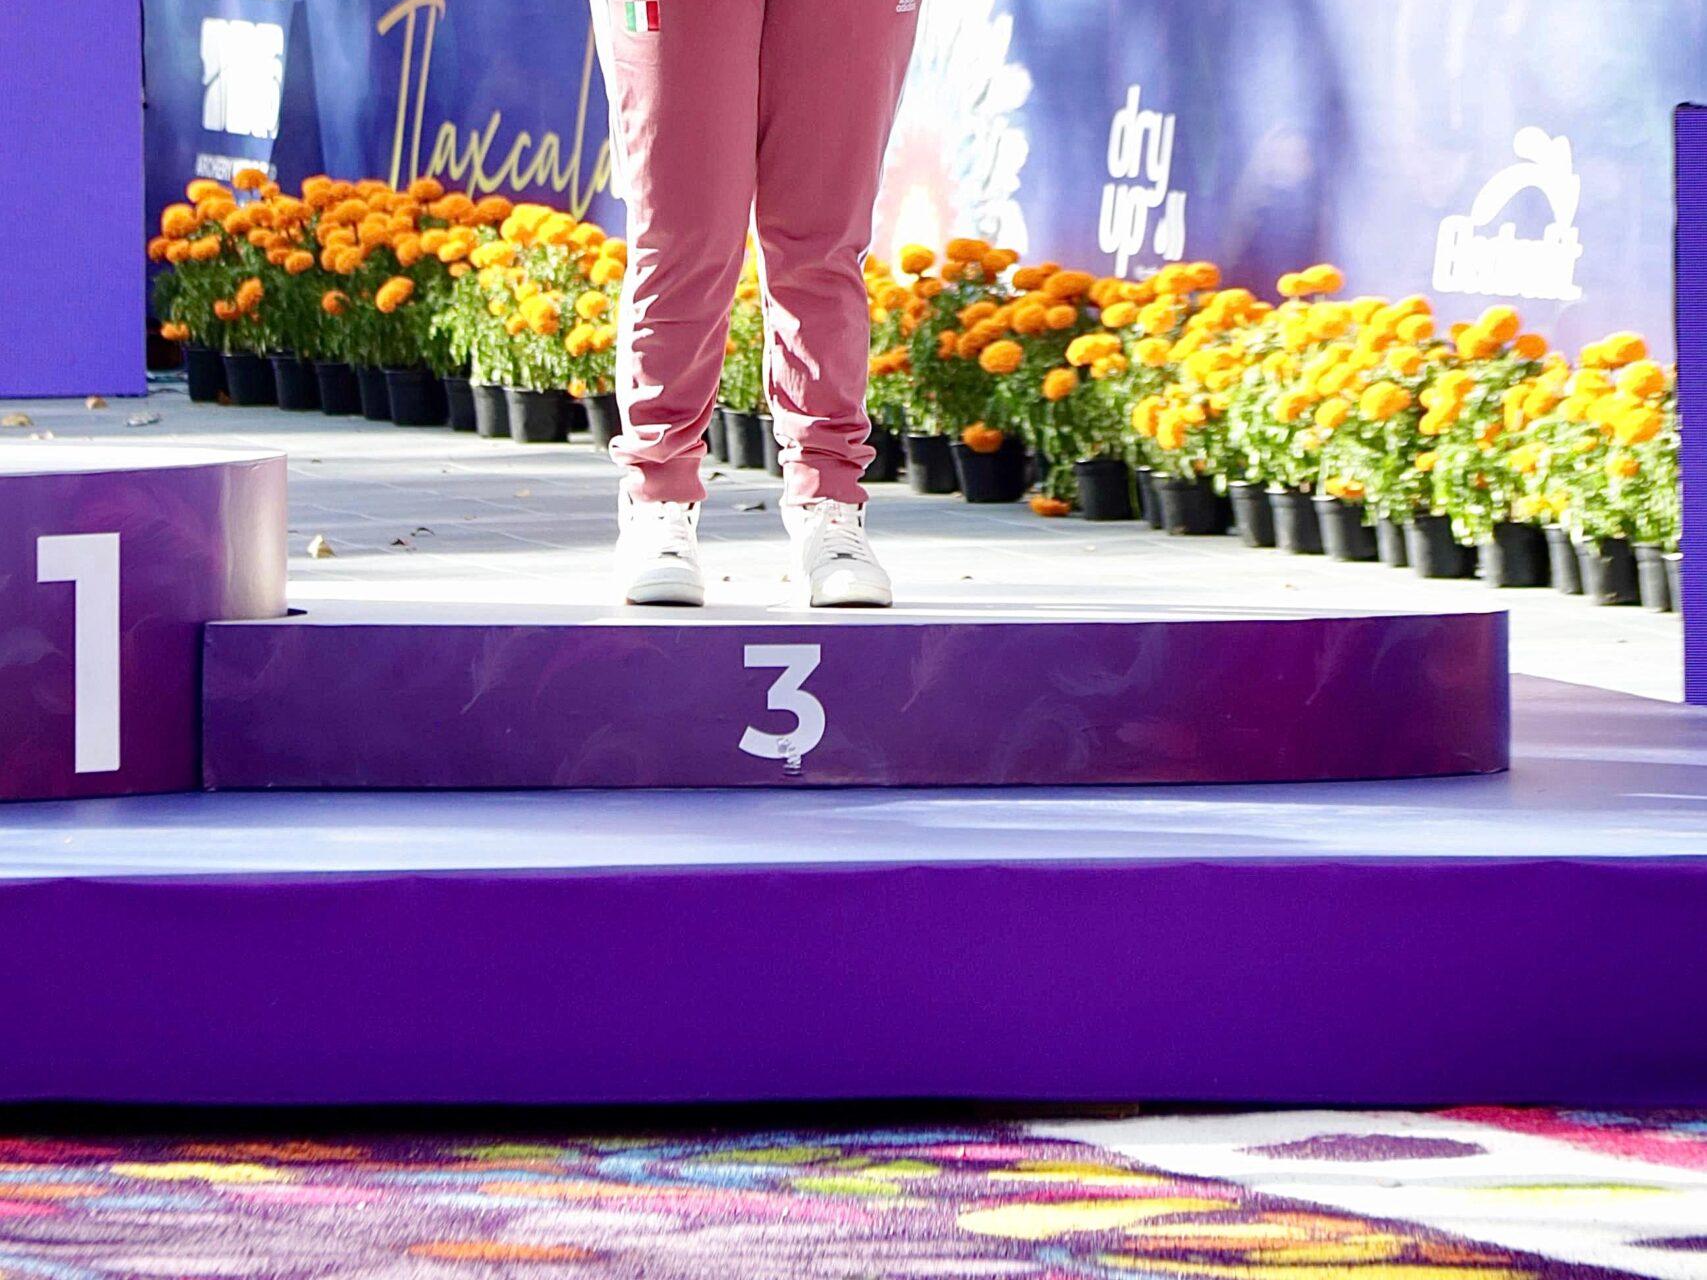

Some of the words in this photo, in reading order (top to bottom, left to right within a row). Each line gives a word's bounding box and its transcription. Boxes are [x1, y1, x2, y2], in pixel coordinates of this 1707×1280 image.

[1107, 84, 1177, 208] dry
[1098, 183, 1150, 278] up
[37, 532, 121, 773] 1
[738, 644, 826, 760] 3
